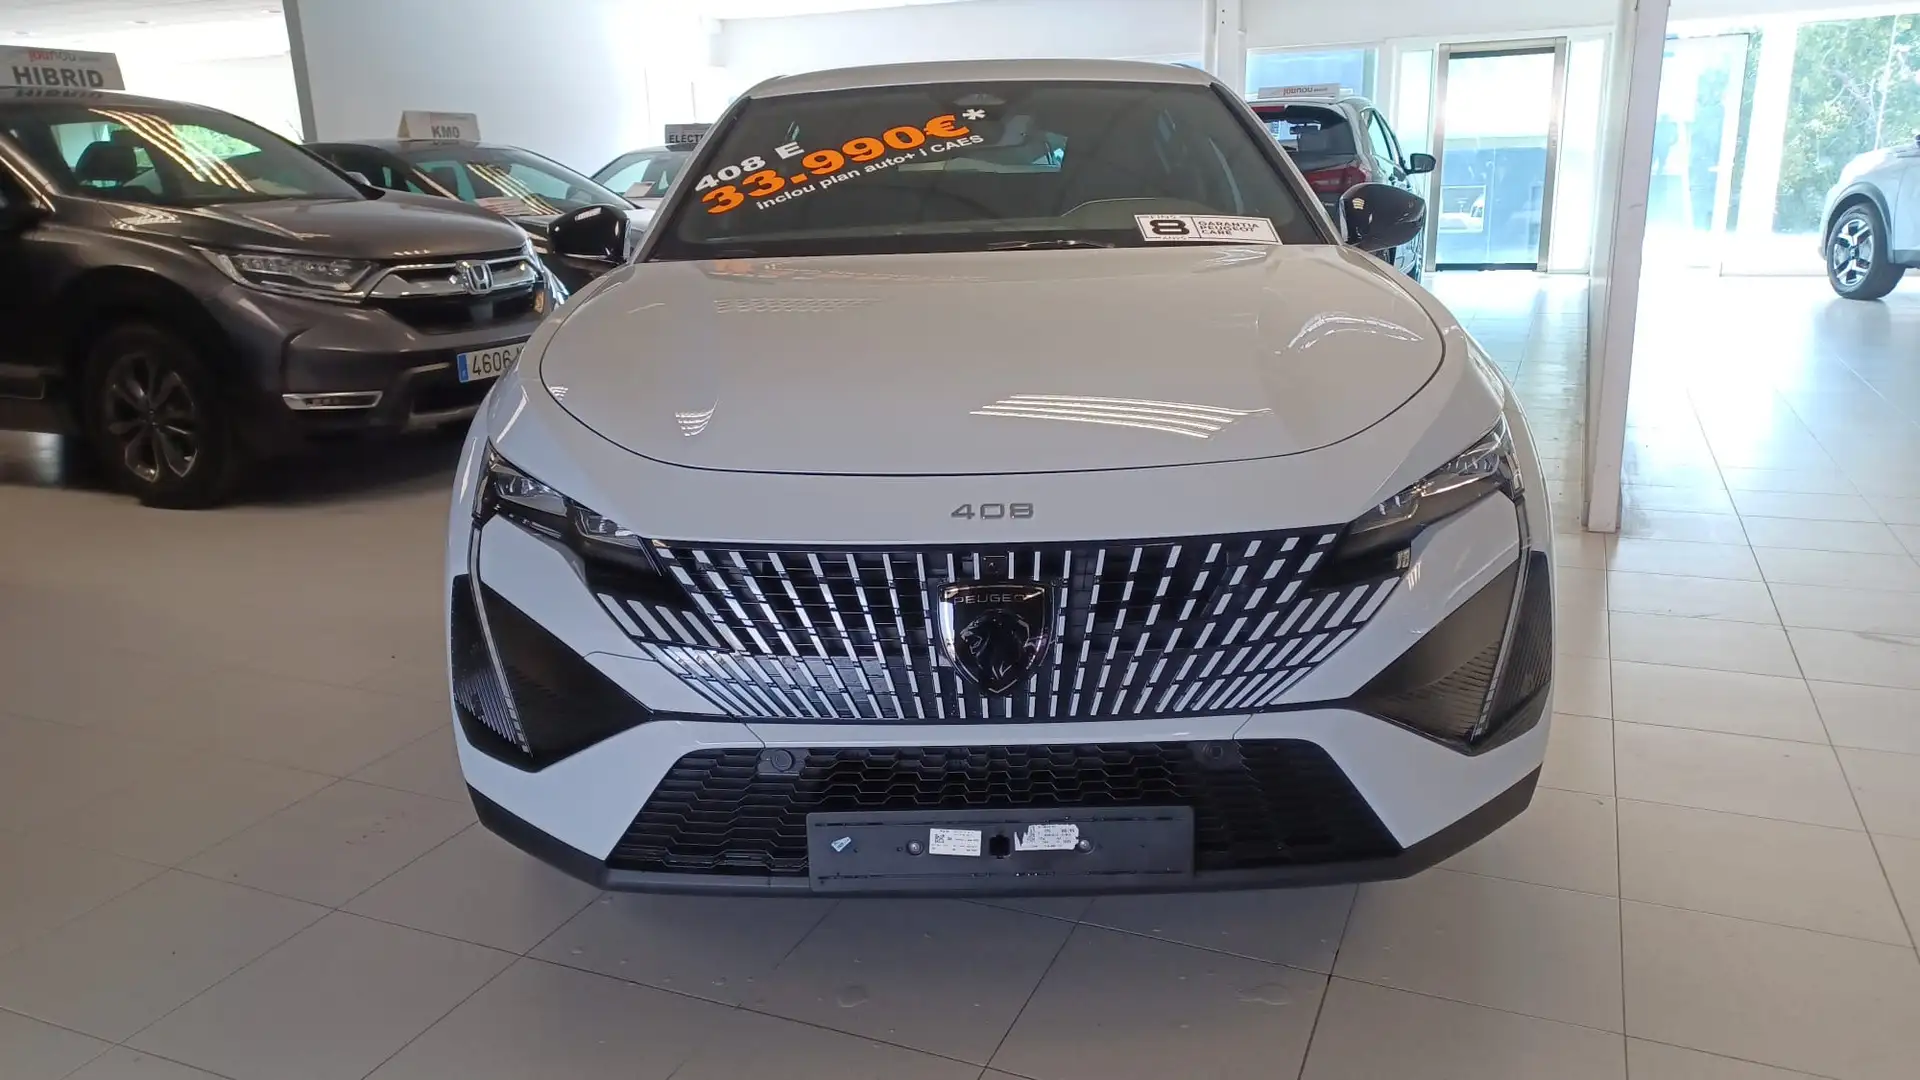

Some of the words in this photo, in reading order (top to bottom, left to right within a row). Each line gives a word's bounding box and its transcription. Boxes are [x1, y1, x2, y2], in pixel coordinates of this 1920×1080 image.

[12, 66, 104, 88] HIBRID
[695, 156, 766, 192] 408
[774, 141, 805, 160] E
[755, 182, 816, 210] inclou
[820, 168, 861, 189] plan
[864, 153, 916, 173] auto+
[930, 134, 984, 153] CAES
[1149, 219, 1190, 235] 8
[1198, 220, 1260, 229] GARANTIA
[472, 349, 511, 376] 4606
[951, 503, 1034, 520] 408
[953, 592, 1036, 605] PEUGEO
